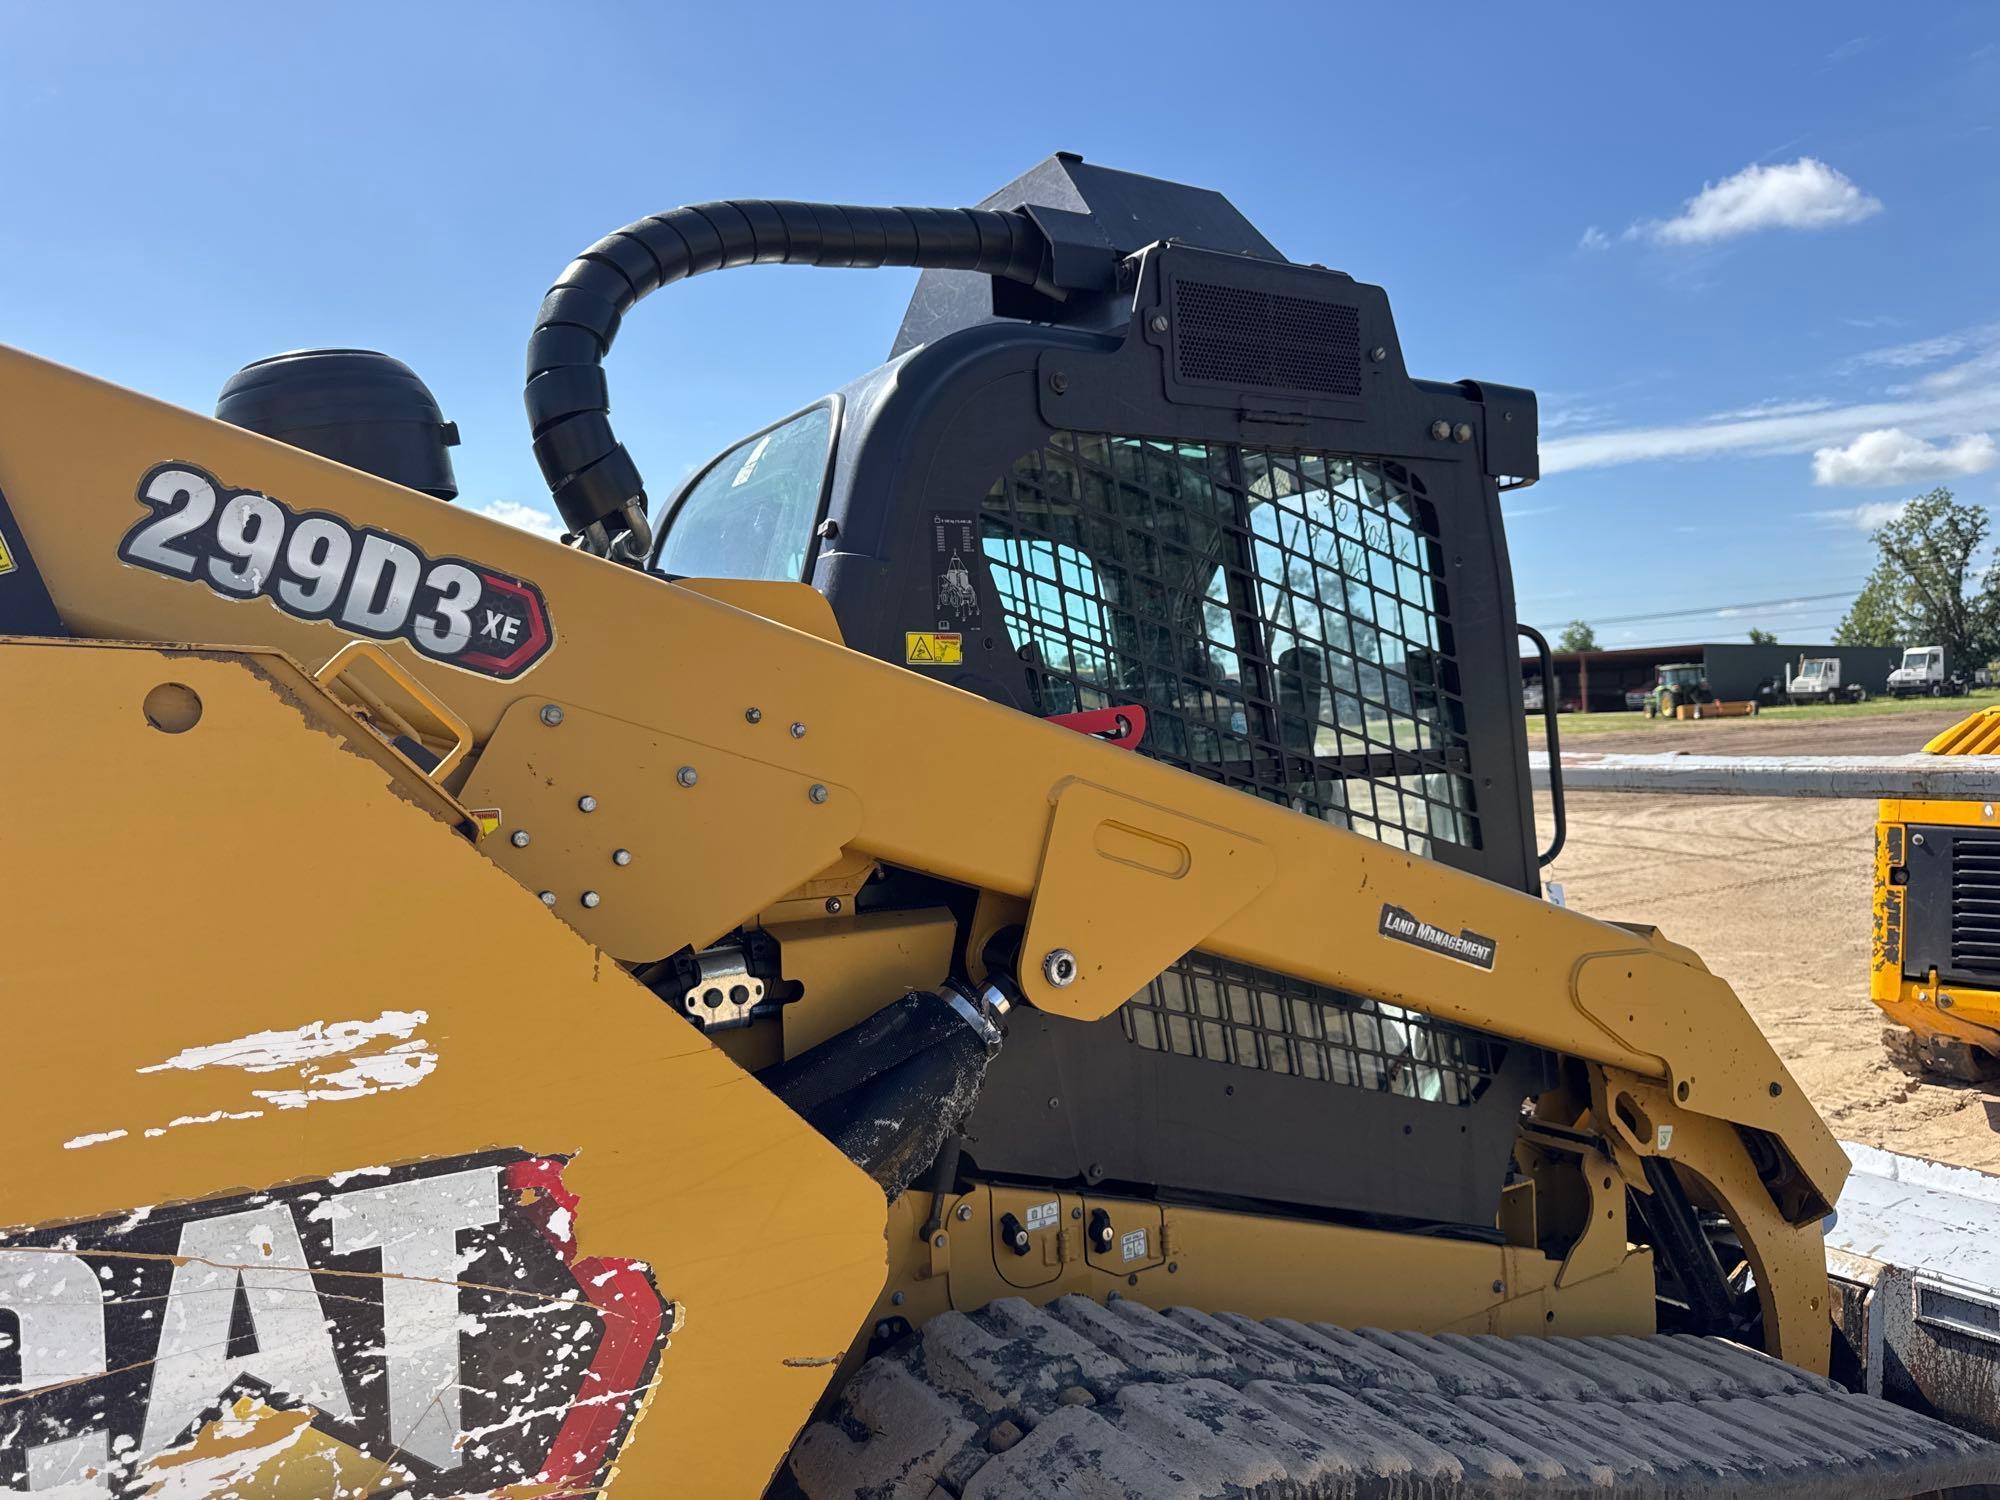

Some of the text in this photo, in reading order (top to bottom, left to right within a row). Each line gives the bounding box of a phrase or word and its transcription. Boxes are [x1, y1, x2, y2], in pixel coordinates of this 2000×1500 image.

[127, 470, 522, 655] 299D3 XE
[1384, 911, 1491, 961] LAND MANAGEMENT
